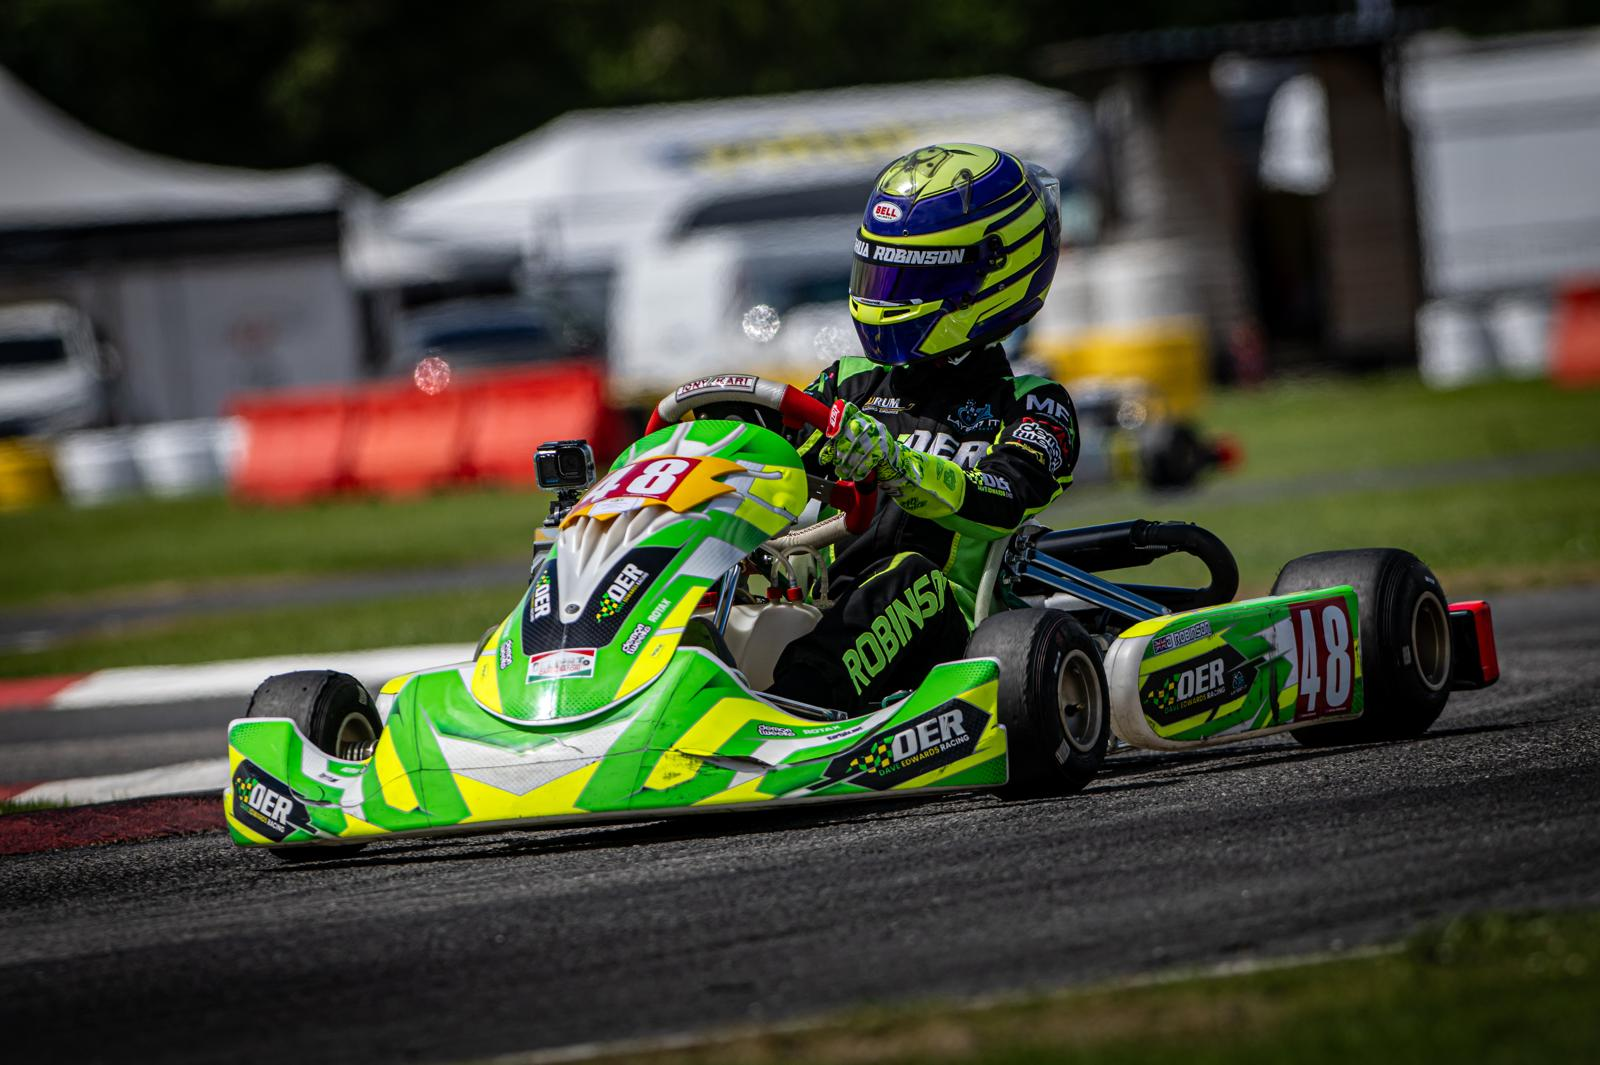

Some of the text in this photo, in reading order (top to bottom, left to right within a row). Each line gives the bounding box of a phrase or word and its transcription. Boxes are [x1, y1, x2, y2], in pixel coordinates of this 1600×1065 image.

[875, 205, 898, 218] BELL
[872, 245, 966, 265] ROBINSON
[581, 458, 691, 503] 48
[534, 583, 552, 620] DER
[607, 563, 646, 604] DER
[647, 597, 672, 623] ROTAX
[622, 623, 645, 652] demon
[1300, 604, 1351, 713] 48
[1176, 657, 1225, 702] DER
[1180, 693, 1207, 709] EDWARDS
[1206, 685, 1226, 699] RACING
[802, 725, 841, 735] ROTAX
[891, 708, 967, 763] DER
[878, 733, 970, 777] DAVE EDWARDS RACING
[249, 783, 294, 826] DER
